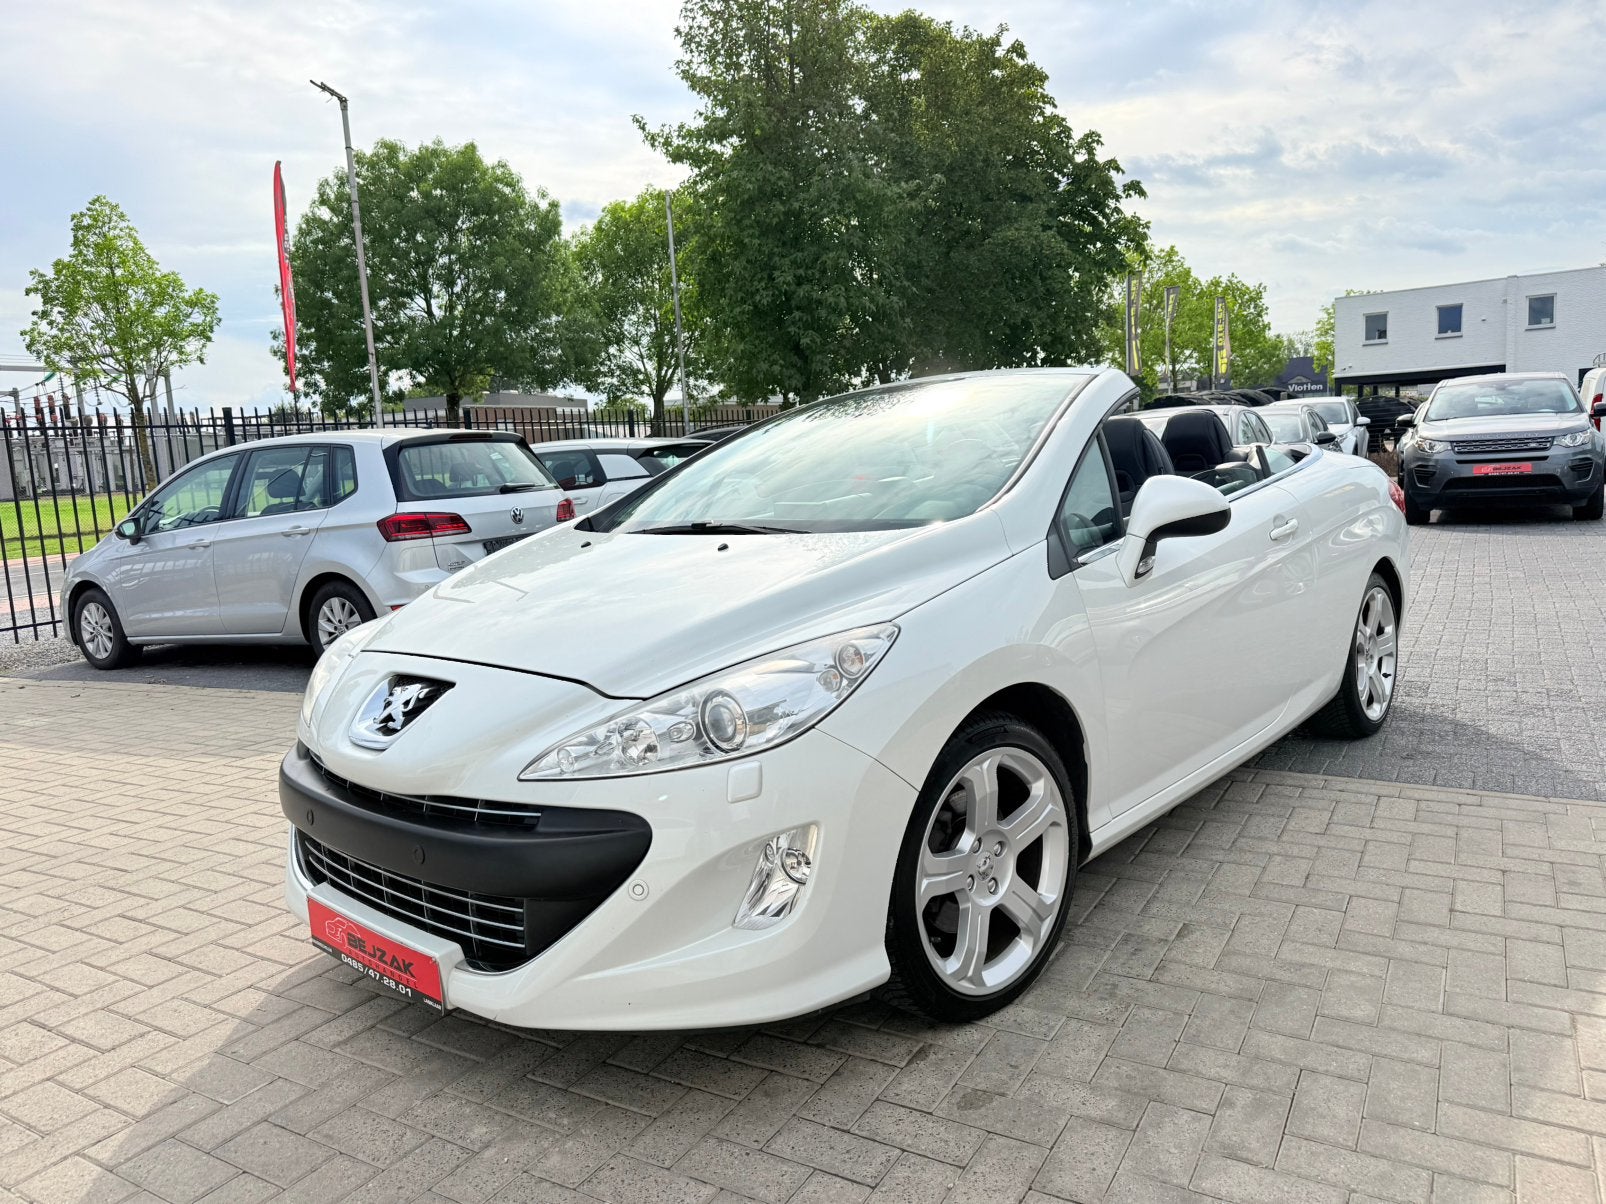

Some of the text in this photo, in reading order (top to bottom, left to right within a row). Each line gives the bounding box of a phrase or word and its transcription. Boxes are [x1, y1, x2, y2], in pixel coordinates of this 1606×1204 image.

[1288, 383, 1324, 392] Vlotten
[341, 953, 412, 998] 0485/47.28.01
[346, 931, 416, 978] BEJZAK
